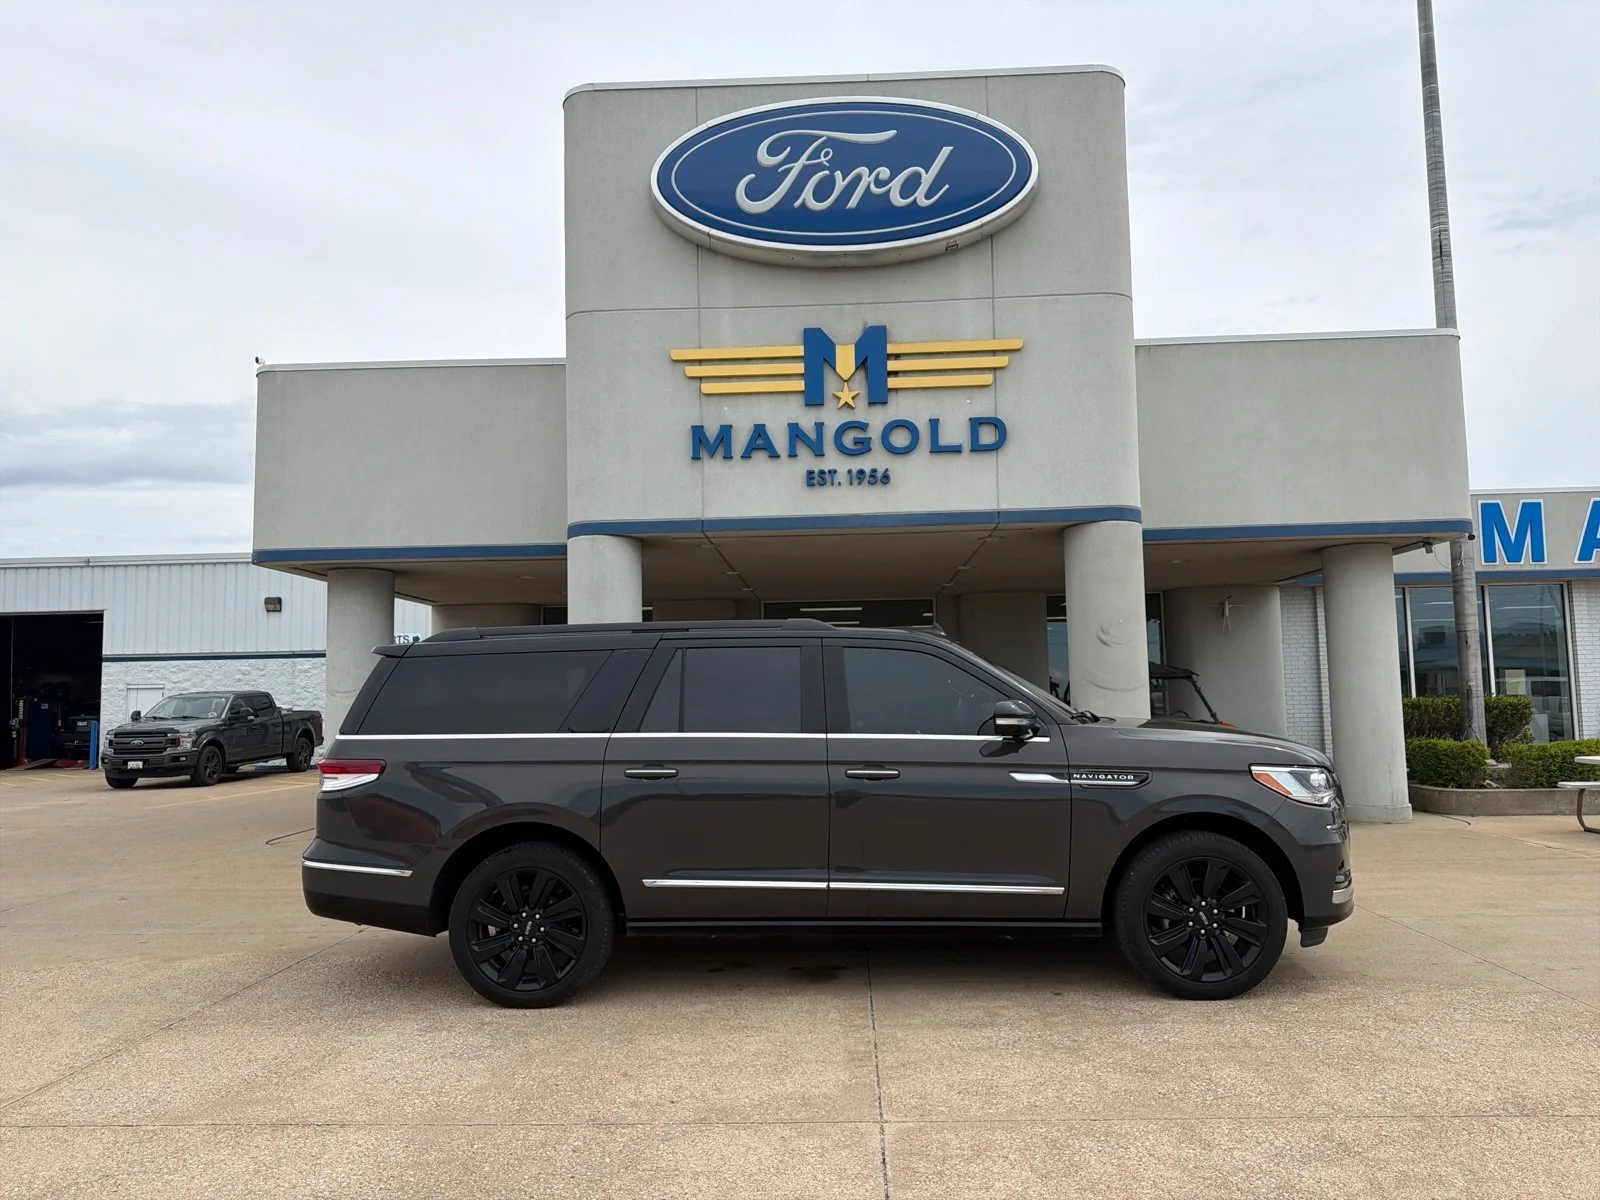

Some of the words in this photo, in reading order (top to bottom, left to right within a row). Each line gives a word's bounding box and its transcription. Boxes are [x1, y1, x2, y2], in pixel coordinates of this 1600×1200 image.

[735, 129, 954, 215] Ford
[803, 325, 888, 406] M
[691, 416, 1007, 460] MANGOLD
[806, 468, 842, 487] EST.
[848, 467, 891, 486] 1956
